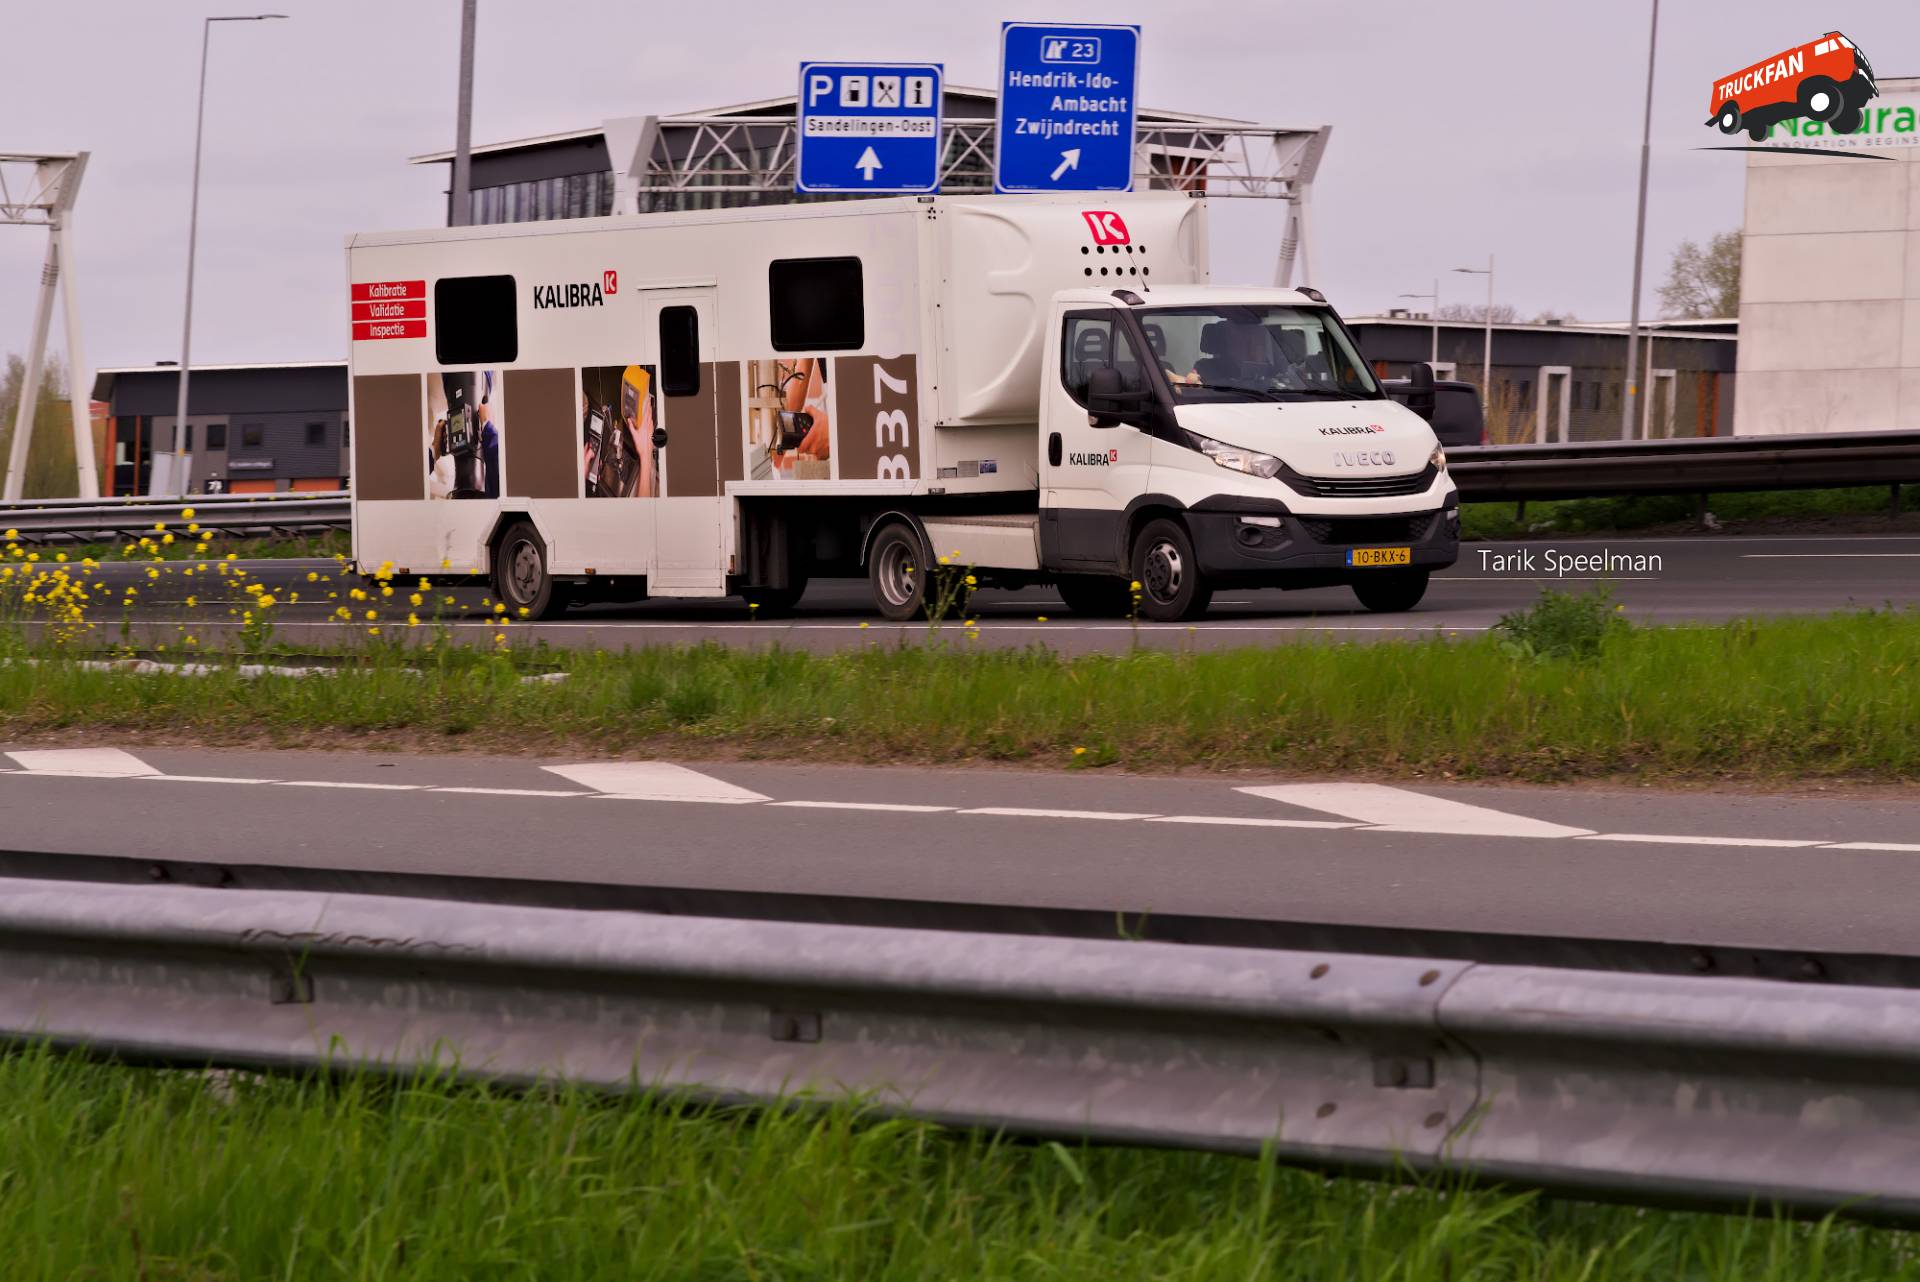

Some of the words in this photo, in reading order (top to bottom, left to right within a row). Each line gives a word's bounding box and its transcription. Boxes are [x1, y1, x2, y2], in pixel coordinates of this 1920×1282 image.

[1071, 43, 1094, 58] 23
[1009, 71, 1119, 88] Hendrik-Ido-
[809, 75, 834, 107] P
[1050, 95, 1127, 113] Ambacht
[808, 118, 931, 135] Sandelingen-Oost
[1015, 117, 1119, 139] Zwijndrecht
[1866, 136, 1920, 146] BEGINS
[1087, 213, 1126, 241] K
[368, 283, 407, 297] Kalibratie
[534, 282, 604, 309] KALIBRA
[369, 302, 405, 317] Validatie
[370, 322, 405, 338] Inspectie
[1318, 425, 1376, 435] KALIBRA
[1069, 453, 1109, 466] KALIBRA
[1333, 450, 1396, 467] IVECO
[1357, 550, 1406, 563] 10-BKX-6
